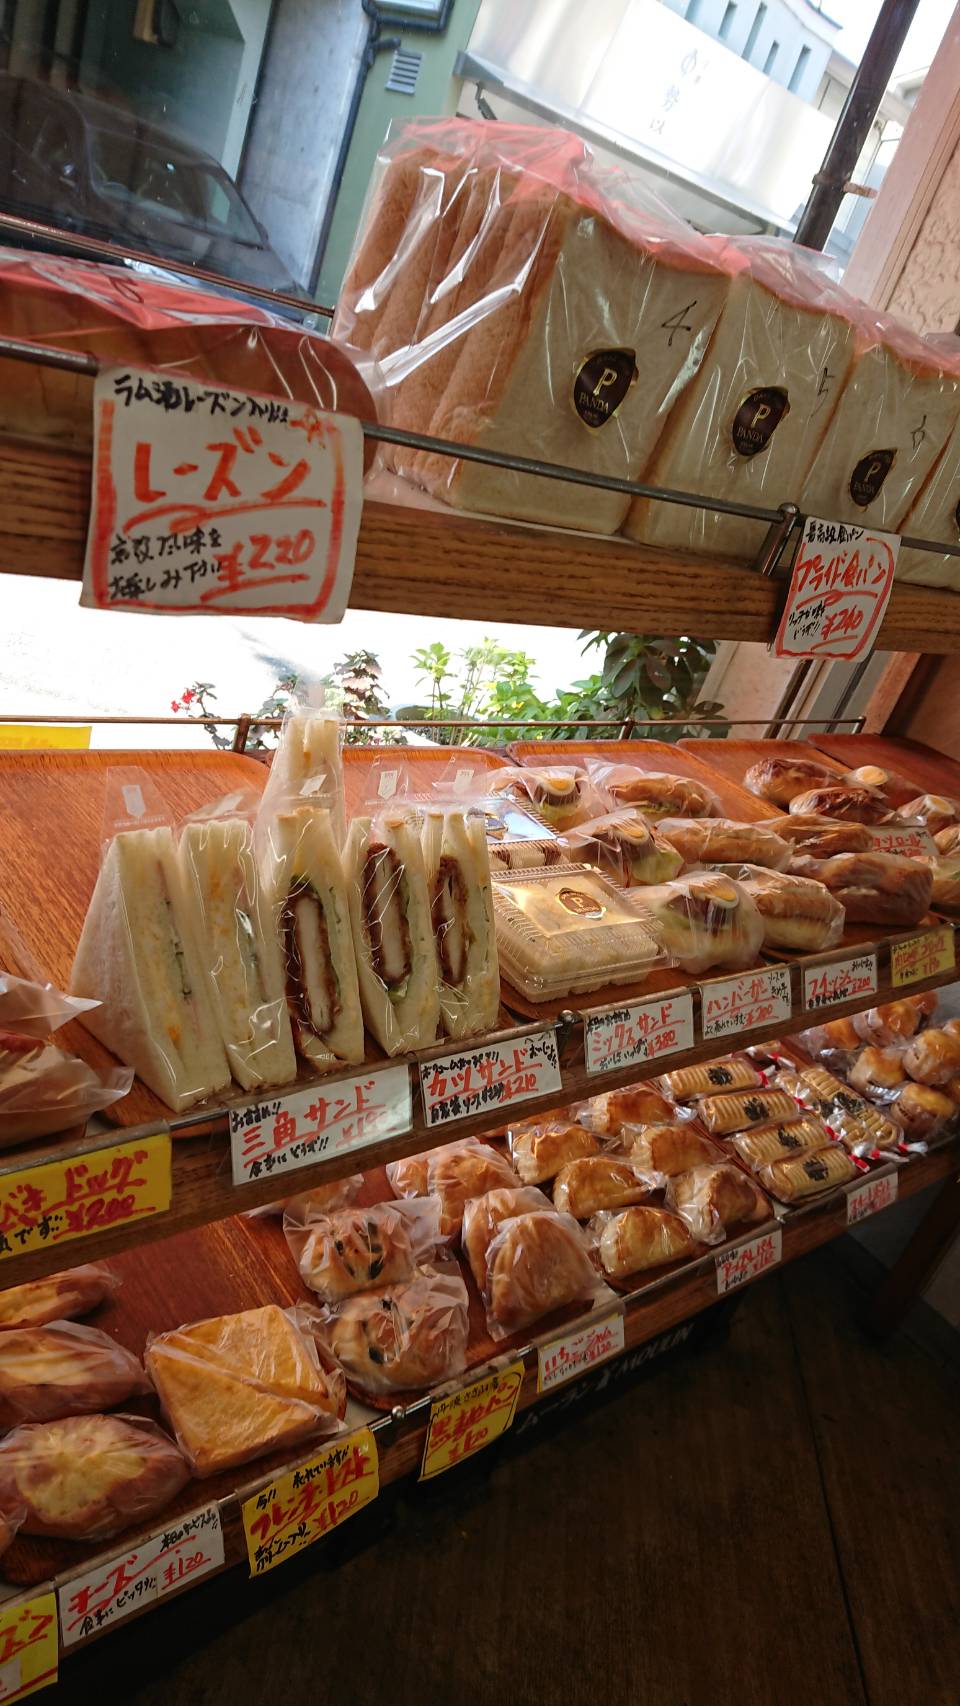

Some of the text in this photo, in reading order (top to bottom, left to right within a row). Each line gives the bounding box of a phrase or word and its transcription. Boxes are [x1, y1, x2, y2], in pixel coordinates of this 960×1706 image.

[661, 300, 697, 346] 4
[593, 368, 618, 396] P
[579, 391, 610, 415] PANDA
[751, 403, 771, 428] P
[736, 426, 765, 444] PANDA
[135, 426, 310, 503] レーズン
[864, 462, 881, 483] P
[821, 605, 863, 640] ¥240
[426, 1048, 528, 1096] カツサンド
[242, 1080, 375, 1155] 三角サンド
[67, 1554, 138, 1614] チーズ
[162, 1552, 204, 1585] ¥120
